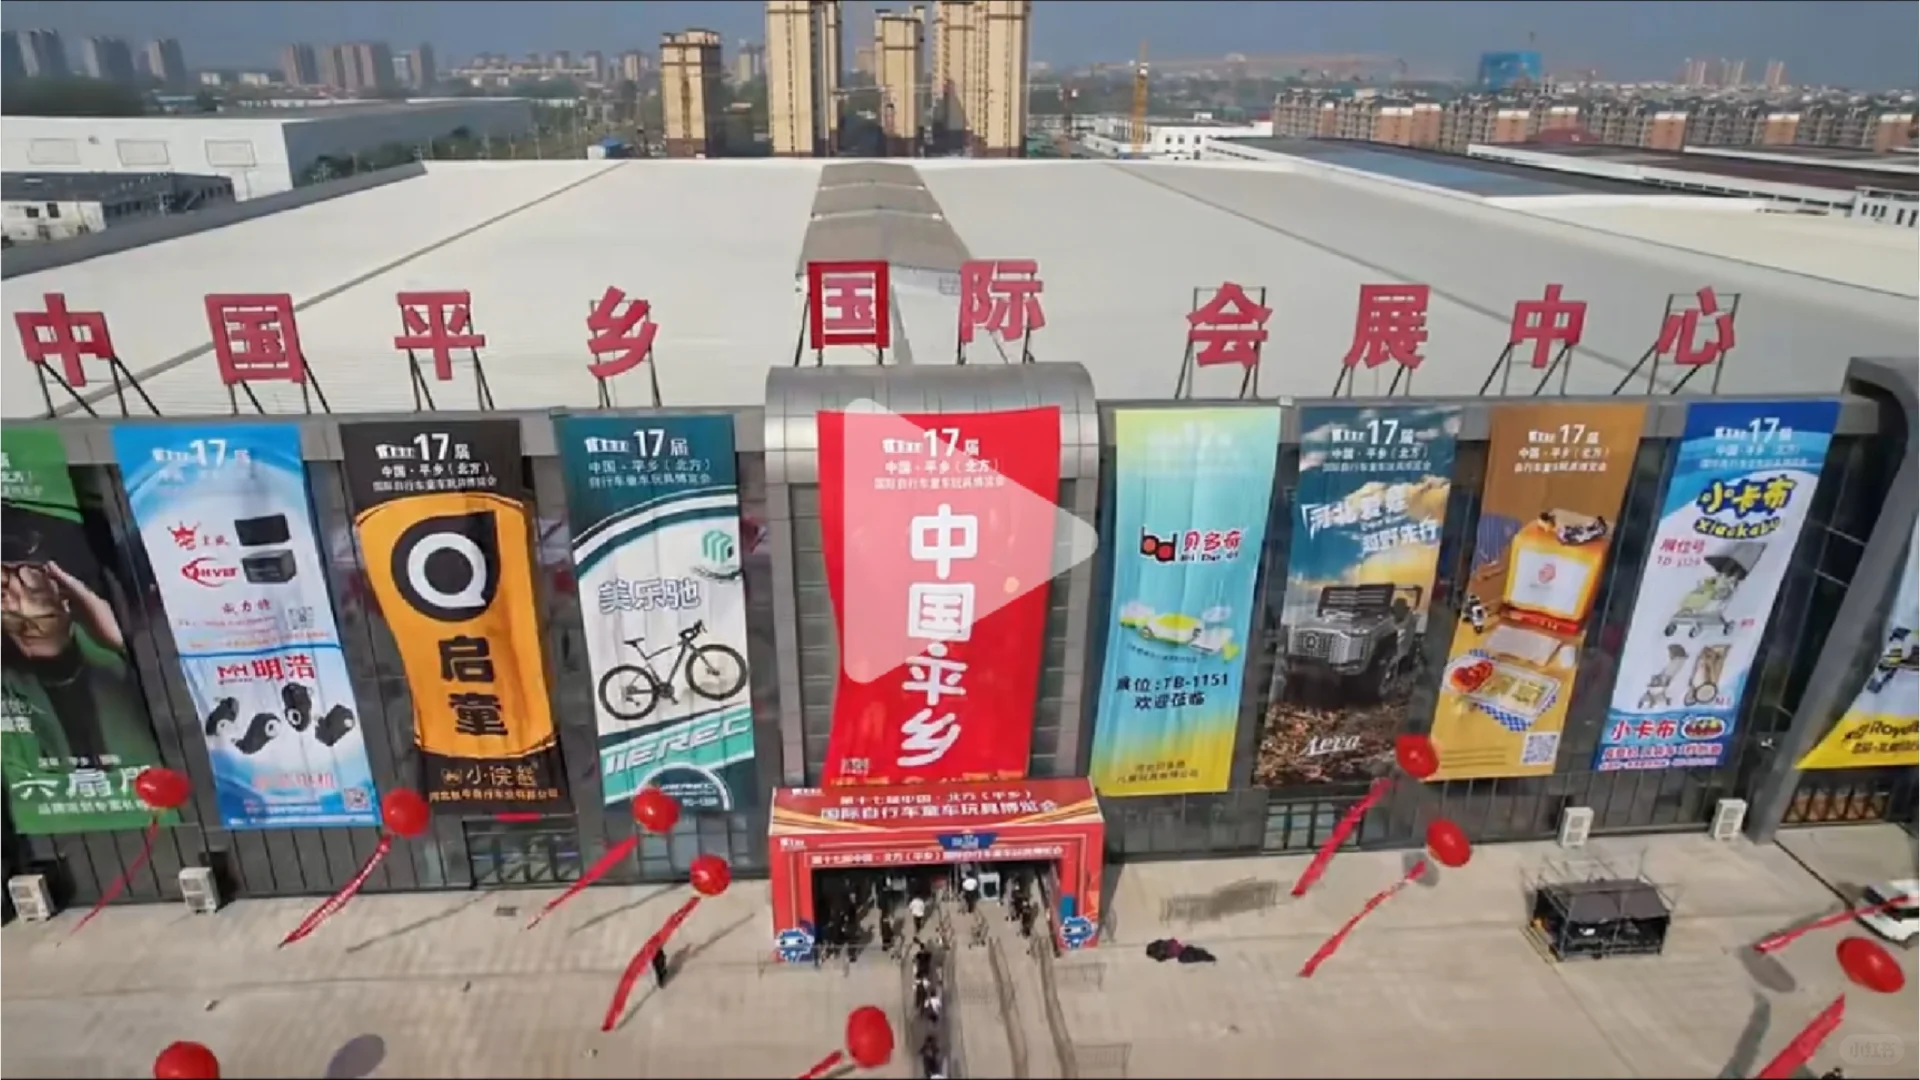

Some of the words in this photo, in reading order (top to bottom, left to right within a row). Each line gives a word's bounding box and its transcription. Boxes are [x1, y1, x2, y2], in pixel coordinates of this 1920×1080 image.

[598, 577, 701, 614] 美乐驰
[252, 654, 315, 681] 明浩
[438, 635, 508, 735] 启童
